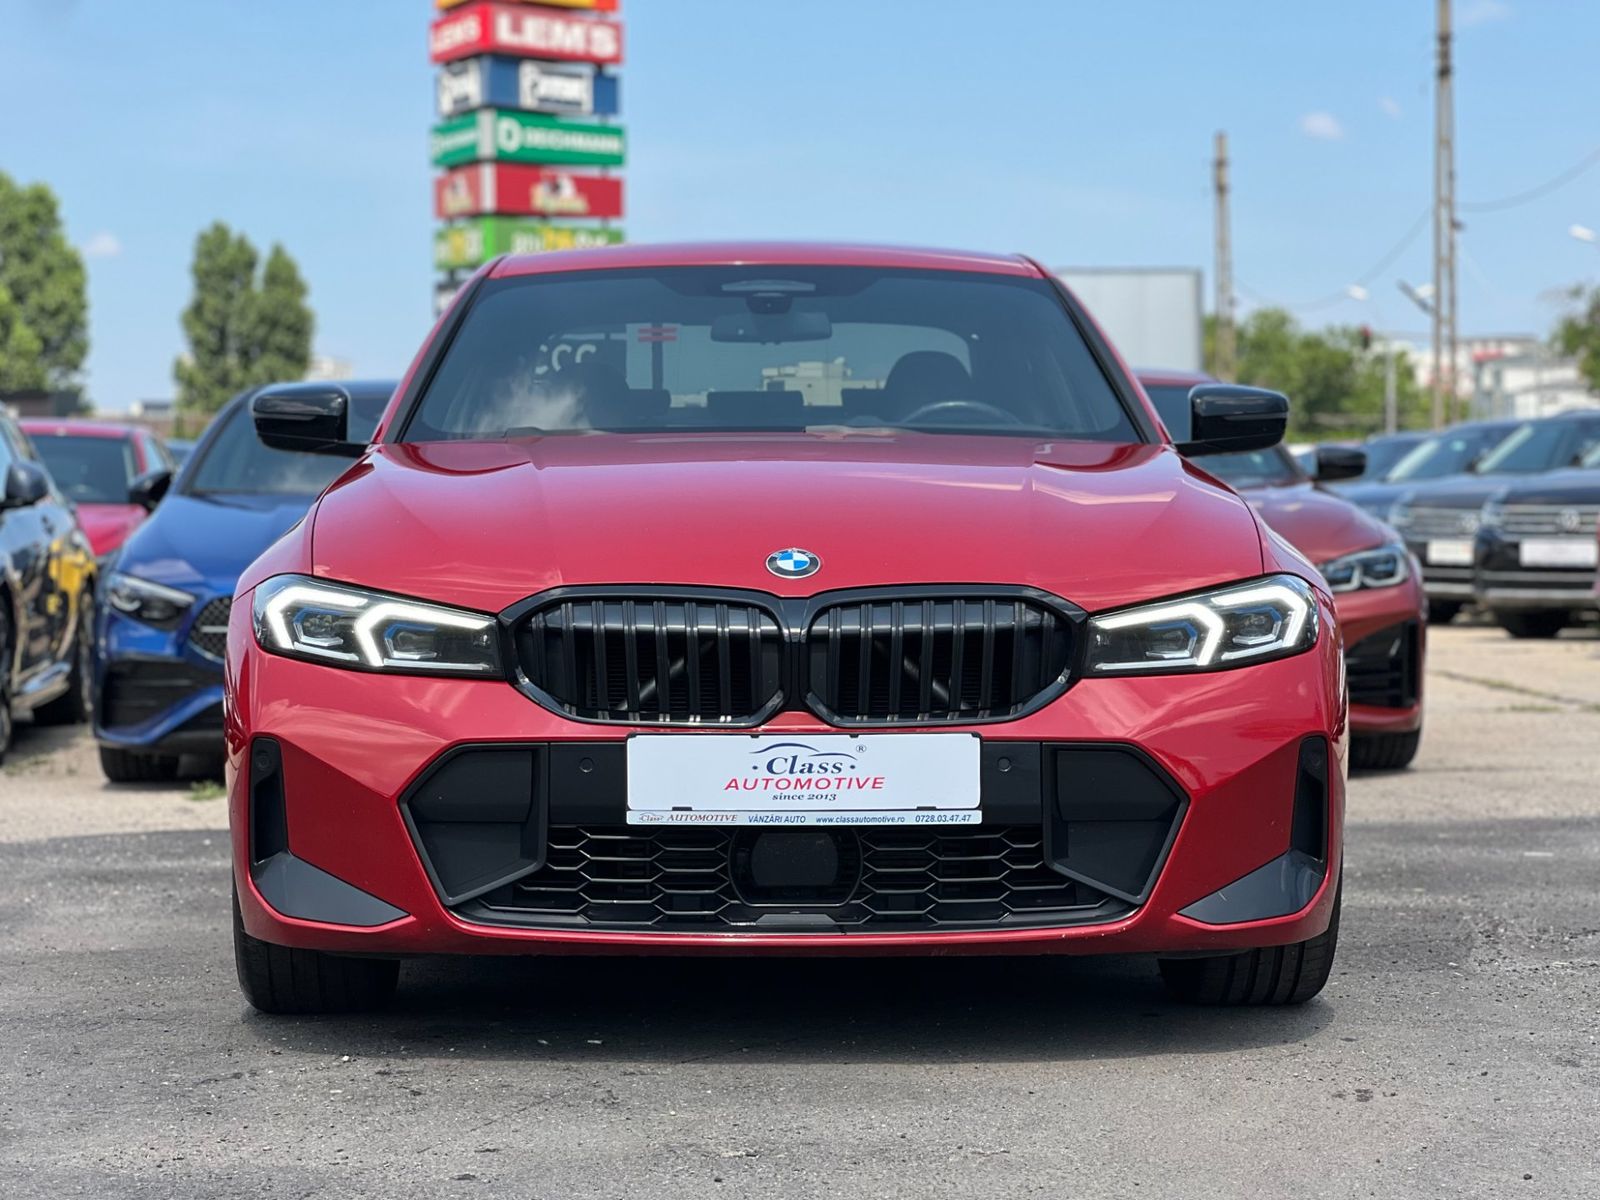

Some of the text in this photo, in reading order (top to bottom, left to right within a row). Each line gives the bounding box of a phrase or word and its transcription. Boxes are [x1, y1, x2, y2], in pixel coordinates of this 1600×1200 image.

[766, 754, 843, 775] Class
[724, 776, 886, 791] AUTOMOTIVE
[772, 792, 837, 801] since 2013
[667, 814, 738, 823] AUTOMOTIVE
[784, 815, 807, 824] AUTO
[816, 814, 905, 824] www.classautomotive.ro
[915, 814, 972, 823] 0728.03.47.47
